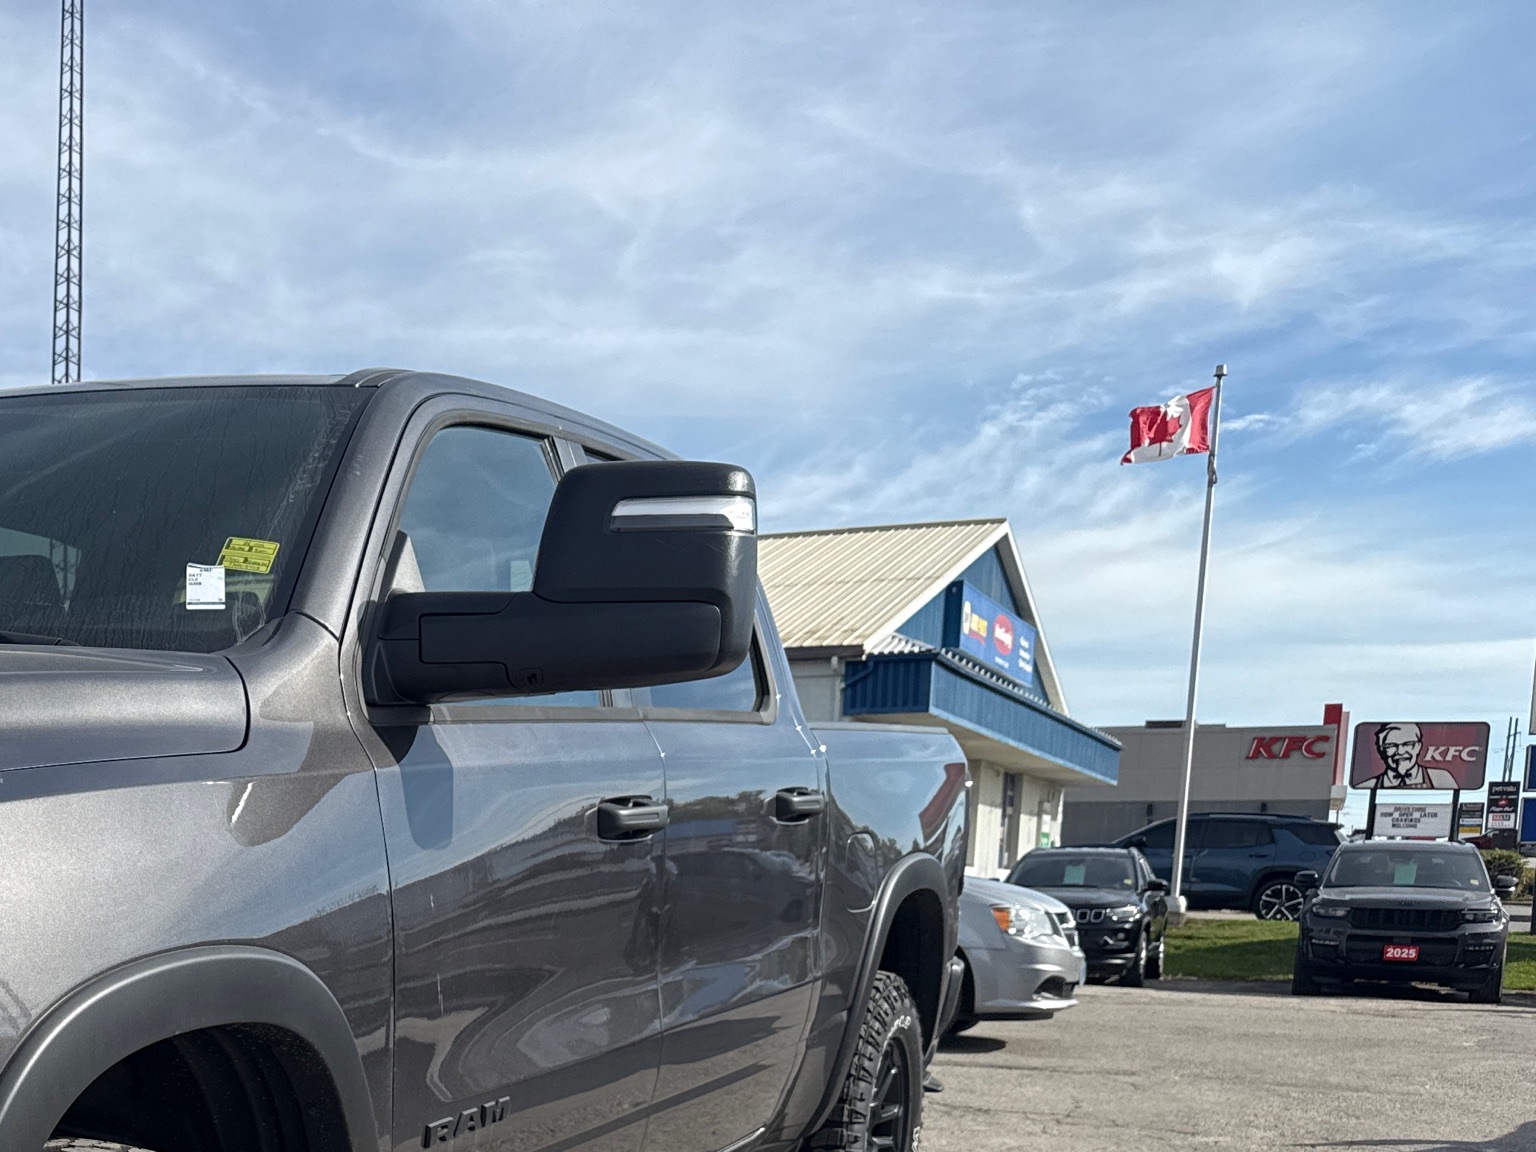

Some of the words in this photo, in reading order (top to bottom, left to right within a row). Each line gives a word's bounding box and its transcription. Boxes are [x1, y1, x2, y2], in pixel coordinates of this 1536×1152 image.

[1245, 735, 1331, 760] KFC
[1423, 746, 1480, 761] KFC
[1386, 948, 1416, 958] 2025
[421, 1096, 510, 1149] RAM
